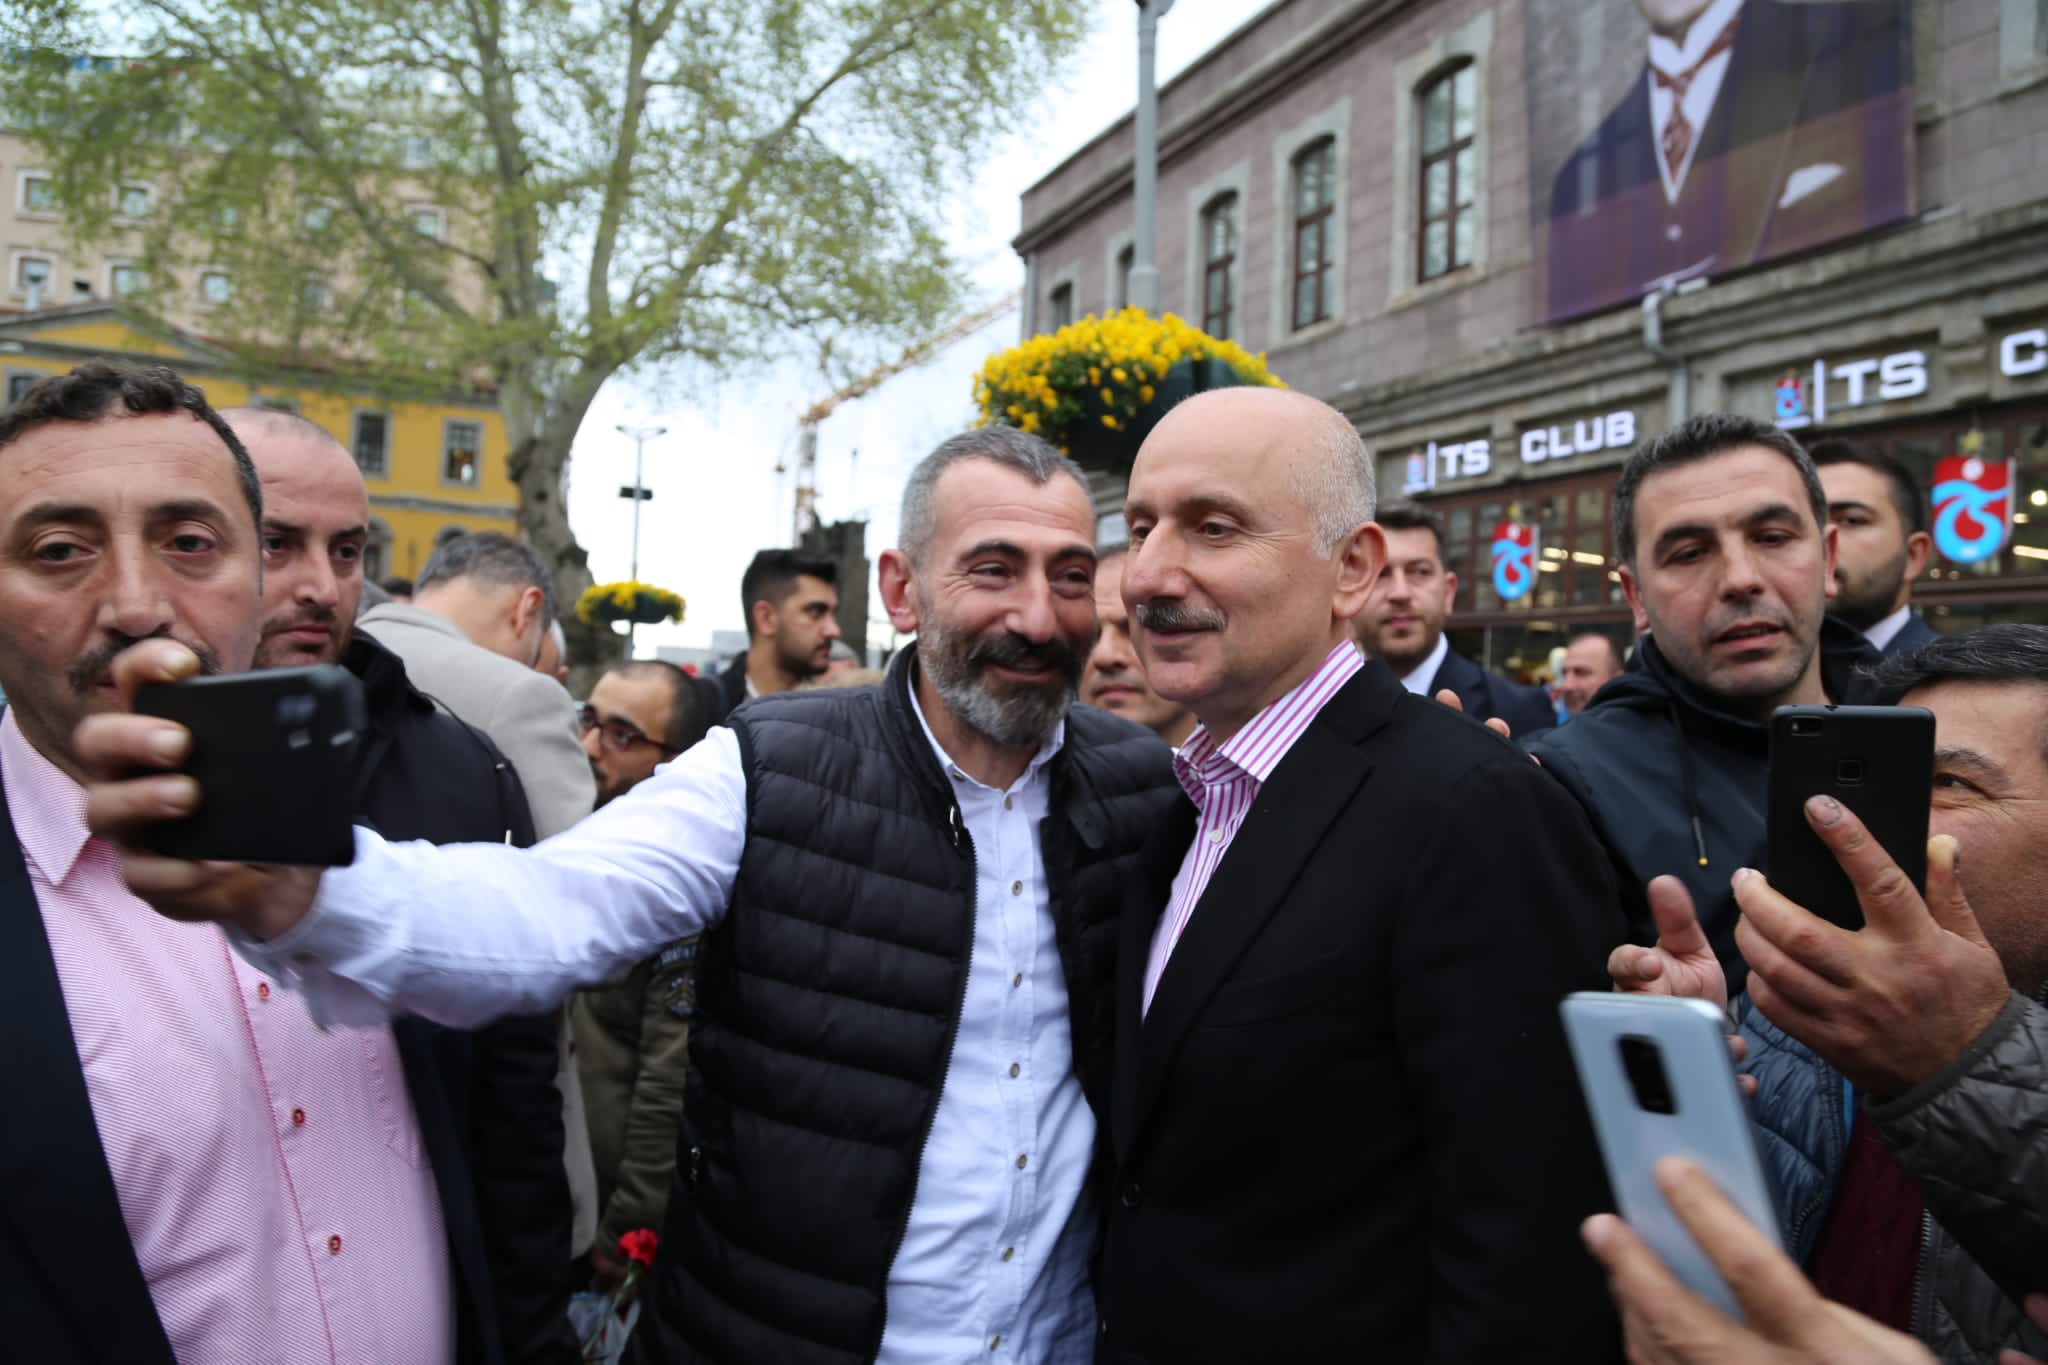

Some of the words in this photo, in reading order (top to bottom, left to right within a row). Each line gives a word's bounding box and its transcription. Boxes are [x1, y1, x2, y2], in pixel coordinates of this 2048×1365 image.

[1832, 351, 1927, 405] TS
[1439, 440, 1490, 479] TS
[1521, 410, 1635, 463] CLUB
